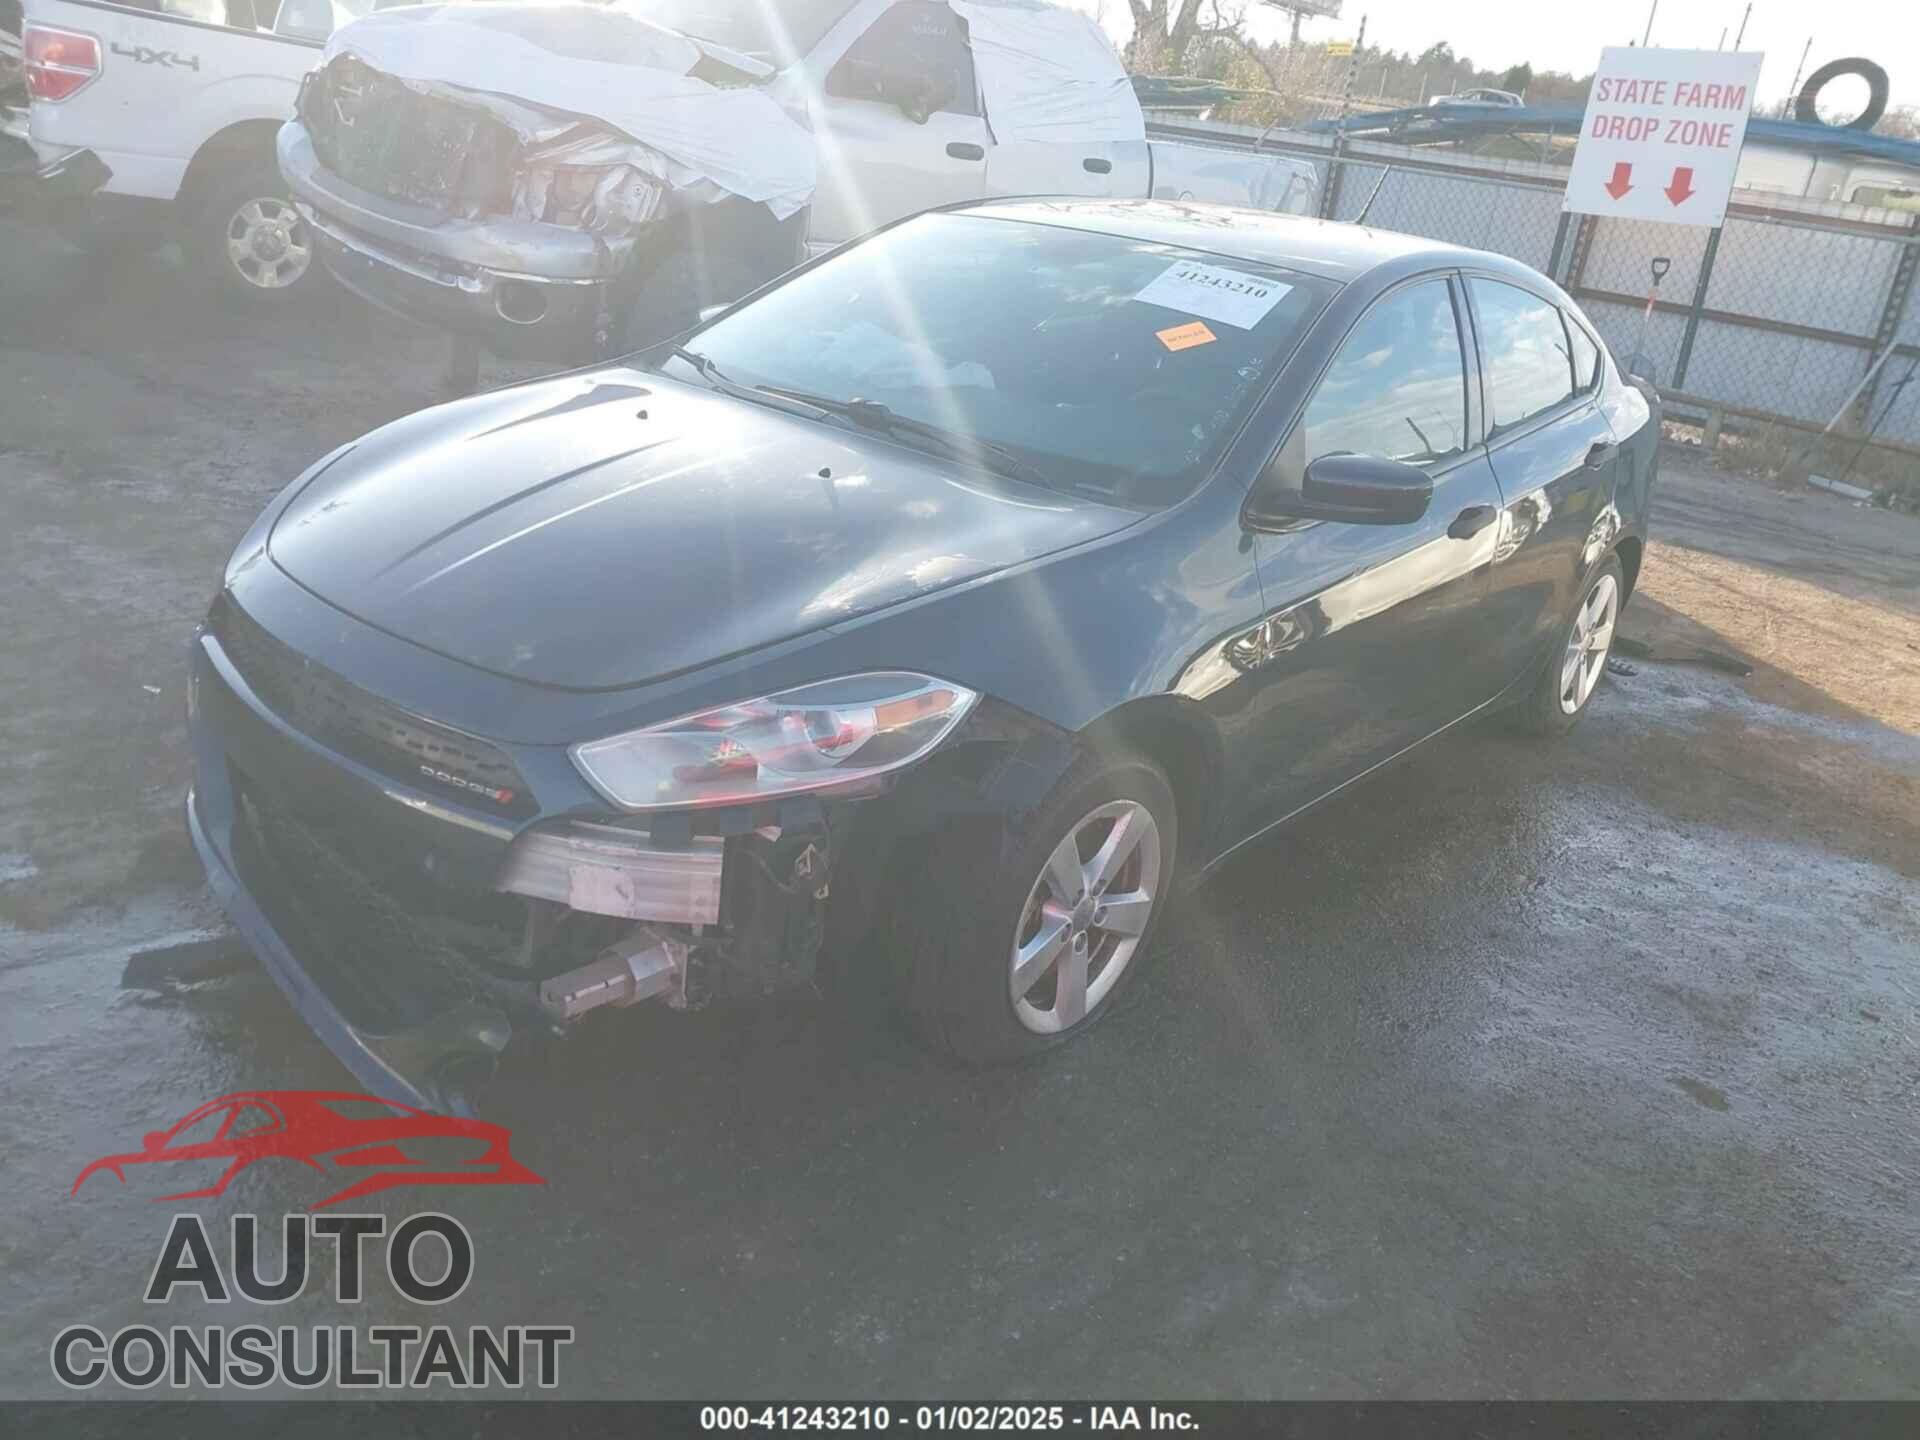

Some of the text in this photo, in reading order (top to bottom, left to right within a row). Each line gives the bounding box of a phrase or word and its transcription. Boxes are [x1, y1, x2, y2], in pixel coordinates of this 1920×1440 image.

[1597, 78, 1747, 111] STATE FARM
[1591, 115, 1734, 148] DROP ZONE
[1173, 269, 1268, 299] 41243210
[421, 765, 499, 799] DODGE
